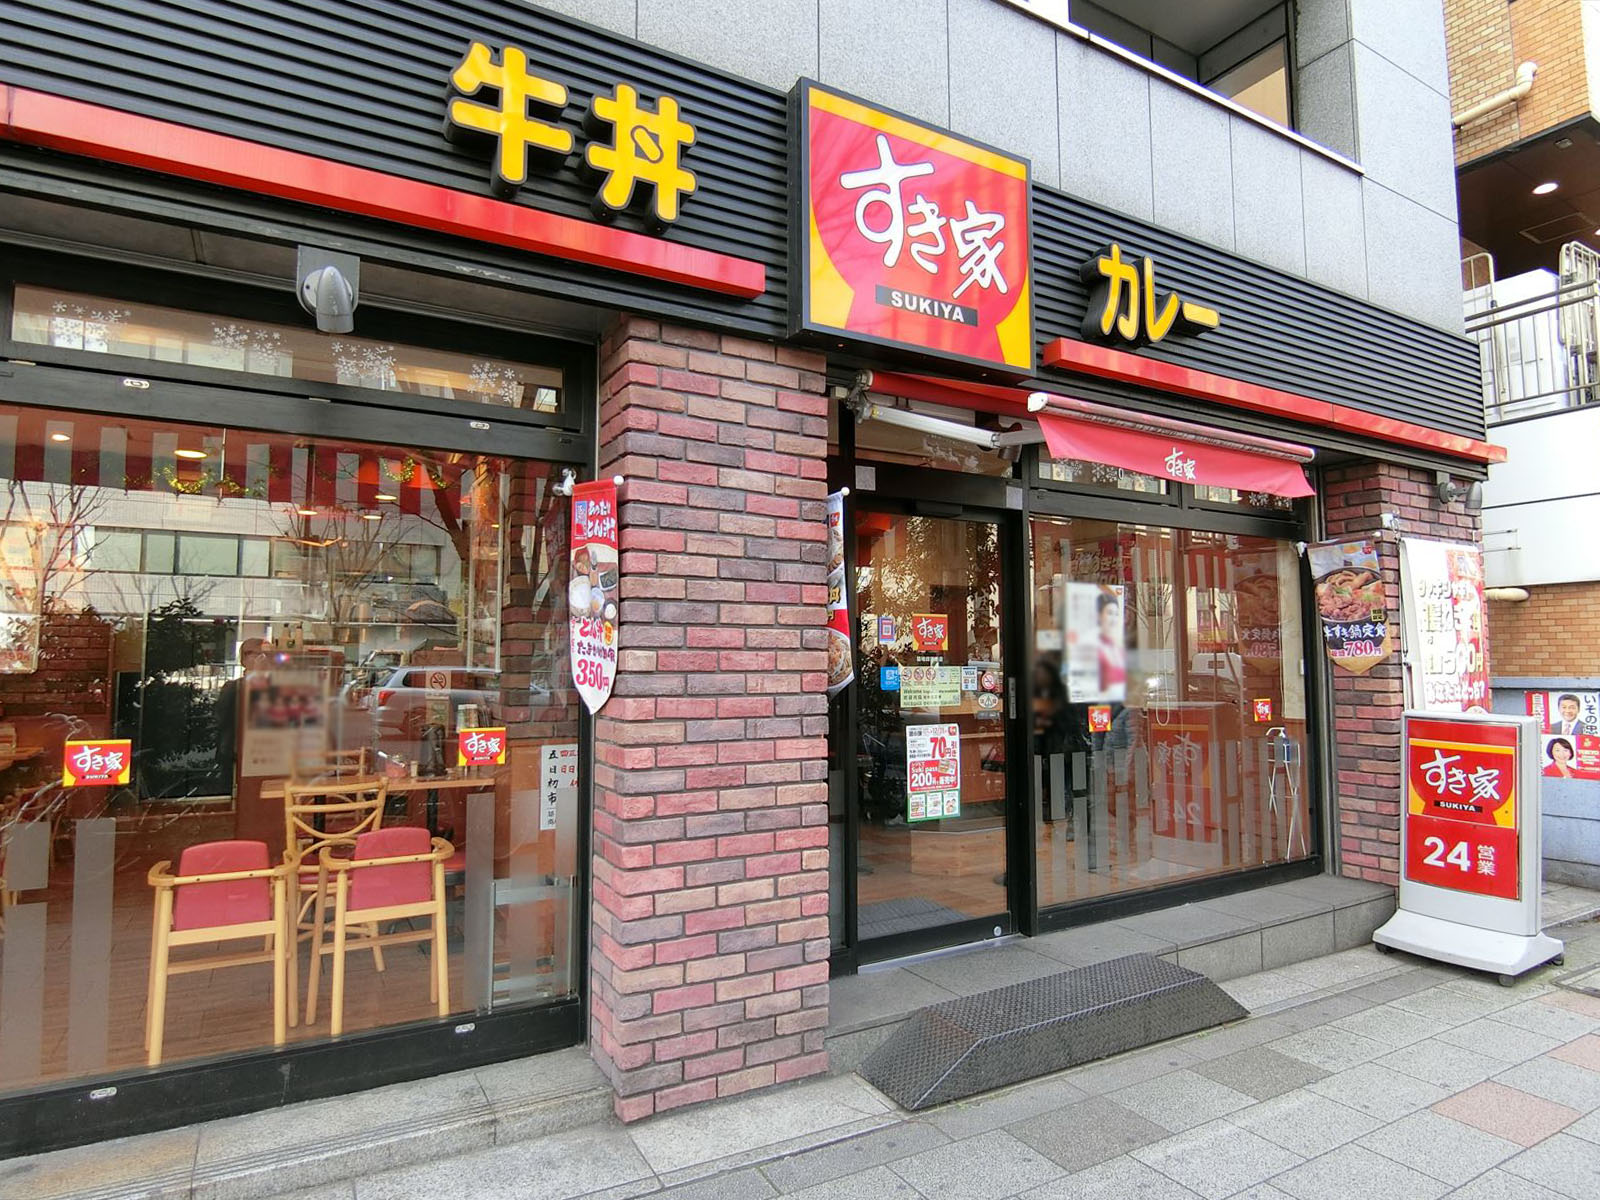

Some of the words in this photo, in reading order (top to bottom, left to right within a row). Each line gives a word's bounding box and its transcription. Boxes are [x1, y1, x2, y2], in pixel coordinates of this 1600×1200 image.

[451, 41, 698, 222] 牛丼
[839, 133, 1009, 299] すき家
[890, 290, 965, 323] SUKIYA
[1098, 242, 1219, 342] カレー
[1164, 447, 1196, 480] すき家
[917, 618, 945, 641] すき家
[576, 659, 609, 693] 350円
[73, 745, 123, 774] すき家
[464, 733, 501, 756] すき家
[548, 750, 559, 805] 五日初市
[1419, 749, 1500, 804] すき家
[1439, 801, 1476, 812] SUKIYA
[1423, 836, 1471, 872] 24
[1477, 844, 1495, 876] 営業
